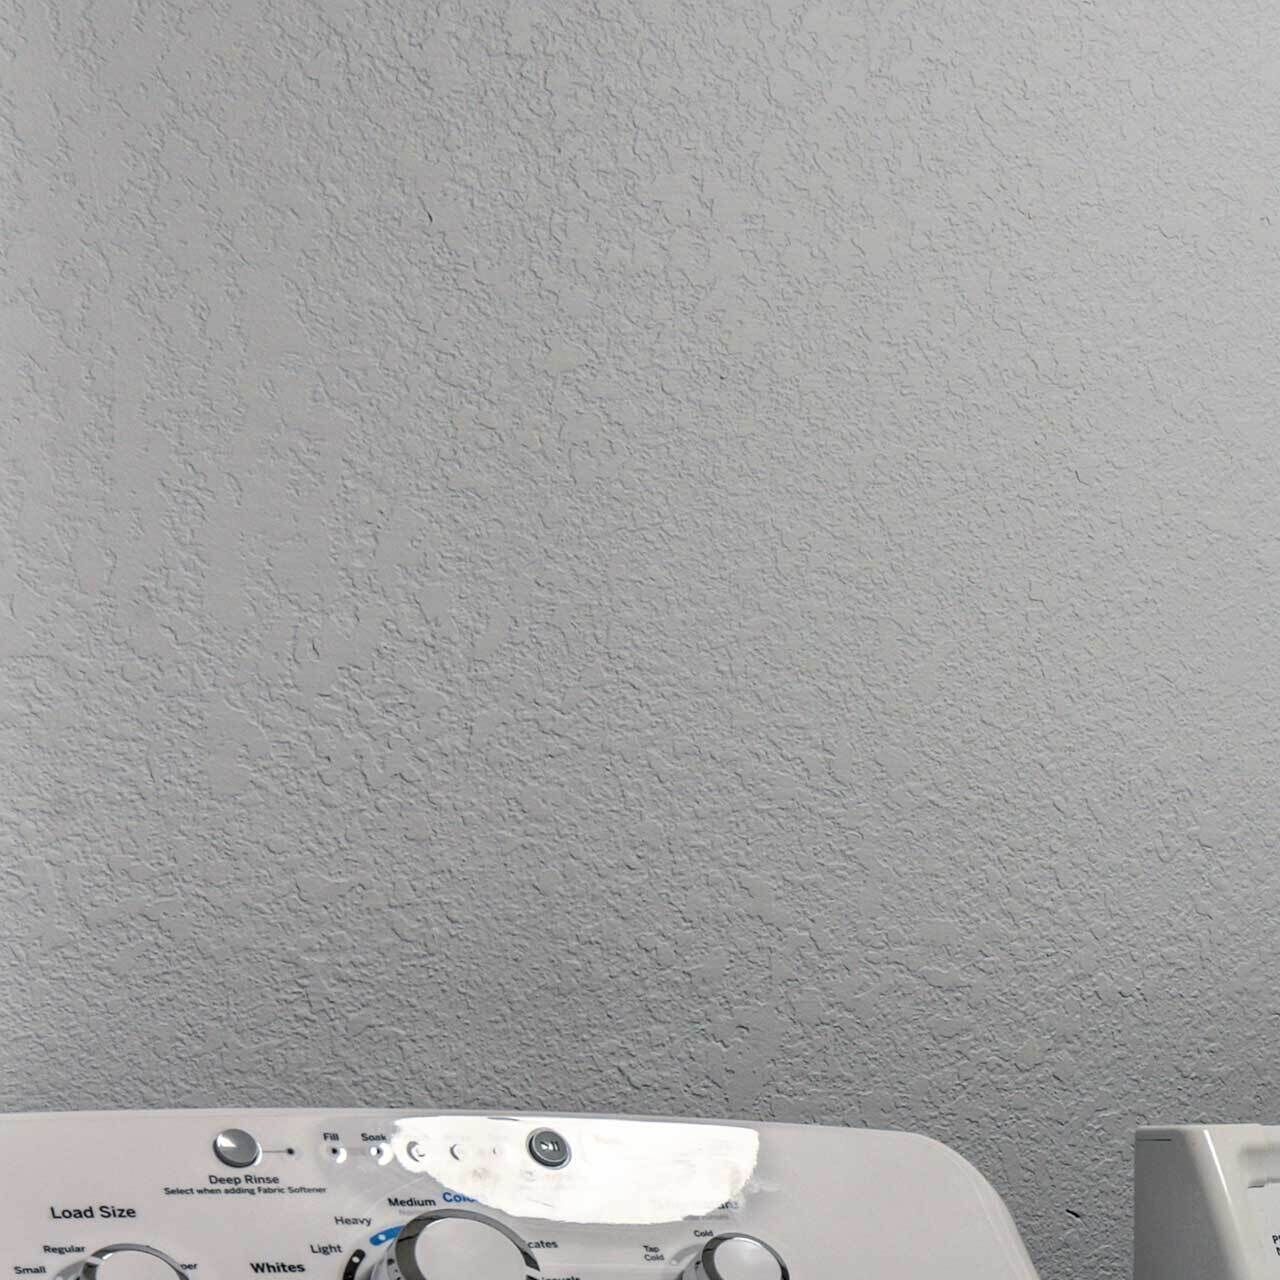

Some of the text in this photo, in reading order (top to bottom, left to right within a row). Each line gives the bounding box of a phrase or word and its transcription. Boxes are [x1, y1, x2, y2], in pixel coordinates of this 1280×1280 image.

[323, 1133, 340, 1141] Fill
[361, 1133, 387, 1142] Soak
[208, 1174, 280, 1186] Deep Rinse
[164, 1185, 327, 1196] Select when adding Fabric Softener
[388, 1197, 437, 1207] Medium
[50, 1205, 137, 1219] Load Size
[335, 1216, 372, 1227] Heavy
[310, 1244, 343, 1255] Light
[527, 1240, 559, 1249] cates
[643, 1245, 660, 1253] Tap
[43, 1245, 86, 1255] Regular
[644, 1254, 665, 1262] Cold
[14, 1266, 46, 1275] Small
[250, 1262, 306, 1274] Whites
